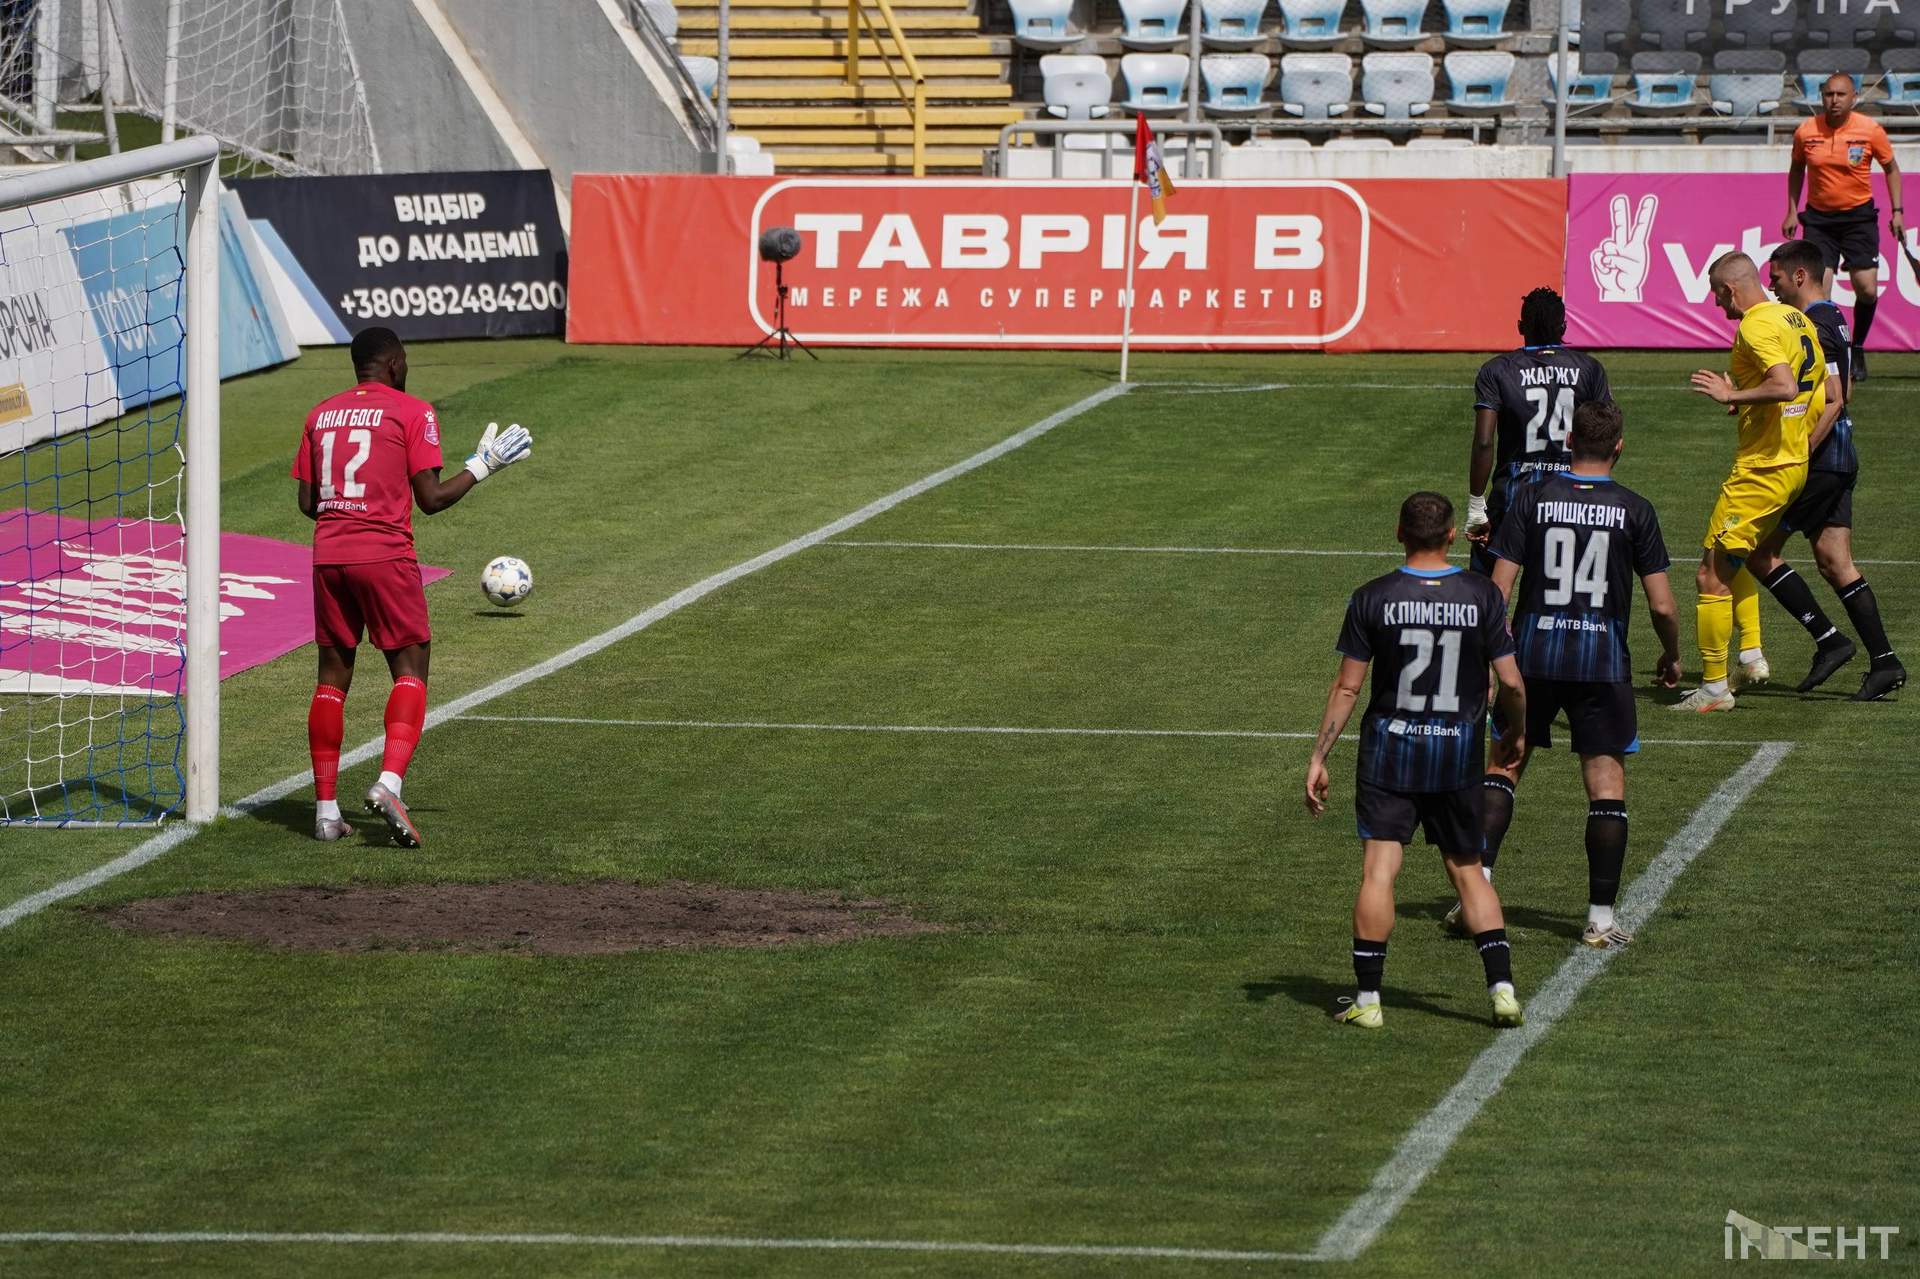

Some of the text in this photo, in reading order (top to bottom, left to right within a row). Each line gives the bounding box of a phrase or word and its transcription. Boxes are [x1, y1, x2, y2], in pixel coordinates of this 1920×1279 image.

[394, 193, 486, 225] ВІДБІР
[358, 223, 539, 268] ДО АКАДЕМІЇ
[794, 213, 1325, 270] ТАВРІЯ В
[340, 281, 566, 319] +380982484200
[791, 287, 1323, 309] МЕРЕЖА СУПЕРМАРКЕТІВ
[1520, 366, 1580, 386] ЖАРЖУ
[1797, 334, 1815, 393] 2
[315, 408, 383, 430] АНІАГБОСО
[1525, 387, 1575, 453] 24
[320, 428, 371, 500] 12
[1553, 463, 1571, 472] Ban
[1537, 501, 1626, 529] ГРИШКЕВИЧ
[1544, 526, 1610, 608] 94
[1384, 601, 1478, 627] КЛИМЕНКО
[1396, 628, 1462, 712] 21
